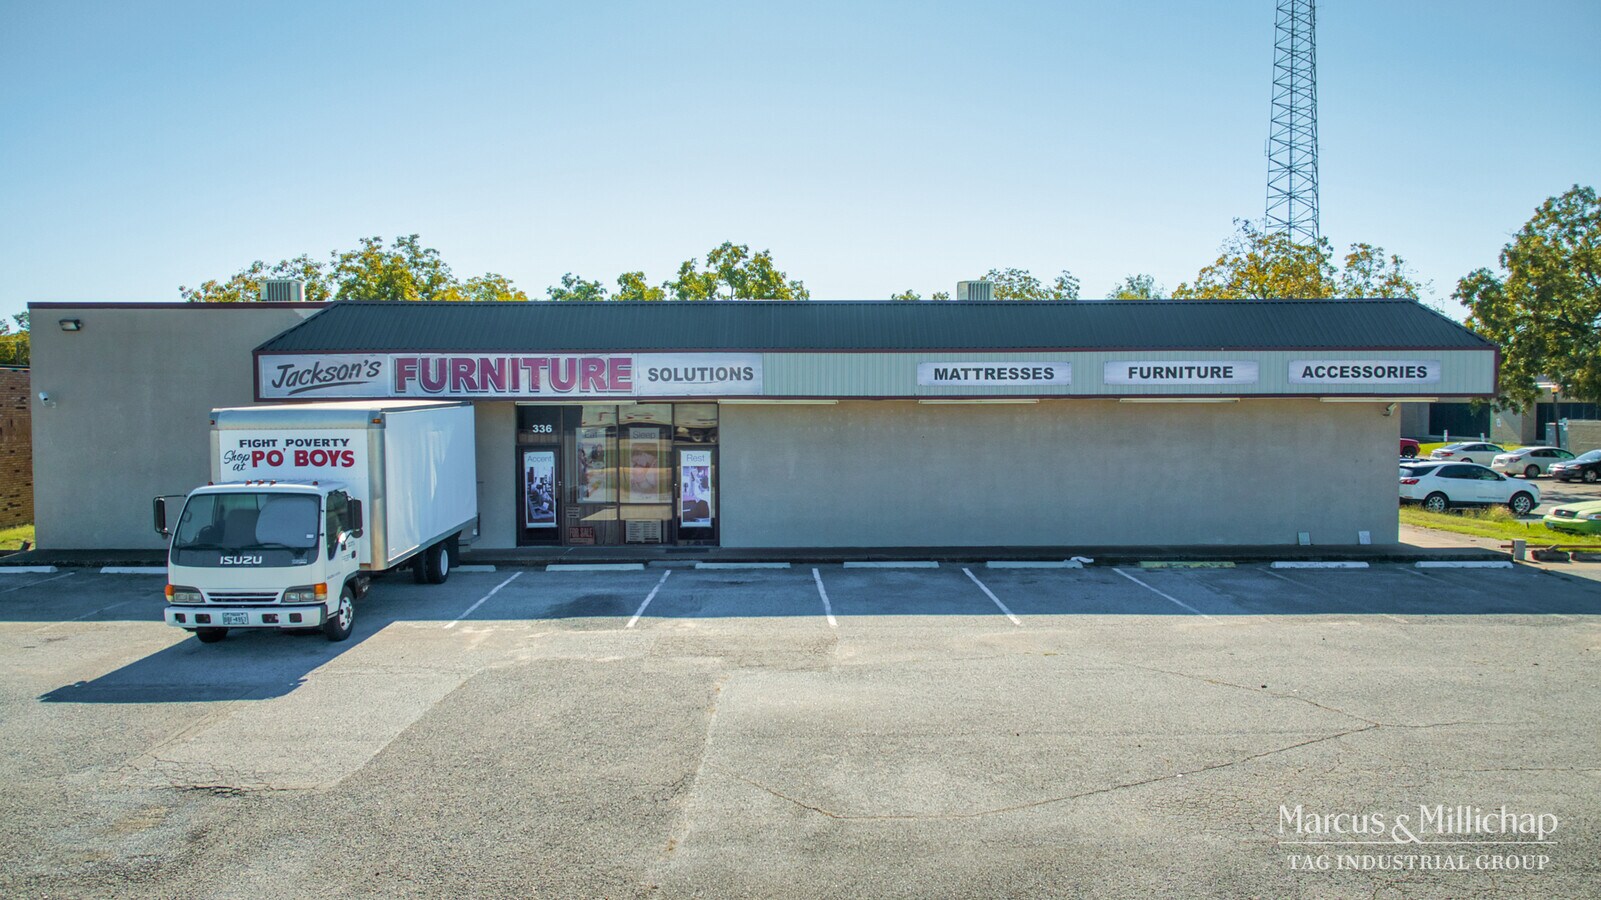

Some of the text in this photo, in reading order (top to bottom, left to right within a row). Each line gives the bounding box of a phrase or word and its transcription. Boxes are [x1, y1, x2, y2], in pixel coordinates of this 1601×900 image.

[271, 357, 754, 394] Jackson's FURNITURE SOLUTIONS
[934, 367, 1055, 381] MATTRESSES
[1128, 365, 1234, 379] FURNITURE
[1301, 365, 1428, 379] ACCESSORIES
[532, 424, 553, 434] 336
[632, 431, 656, 440] Sleep
[239, 438, 350, 448] FIGHT POVERTY
[223, 449, 250, 465] Shop
[294, 449, 355, 468] BOYS
[686, 453, 705, 462] Rest
[232, 462, 247, 471] at
[569, 527, 593, 538] FOR SALE
[220, 555, 263, 565] ISUZU
